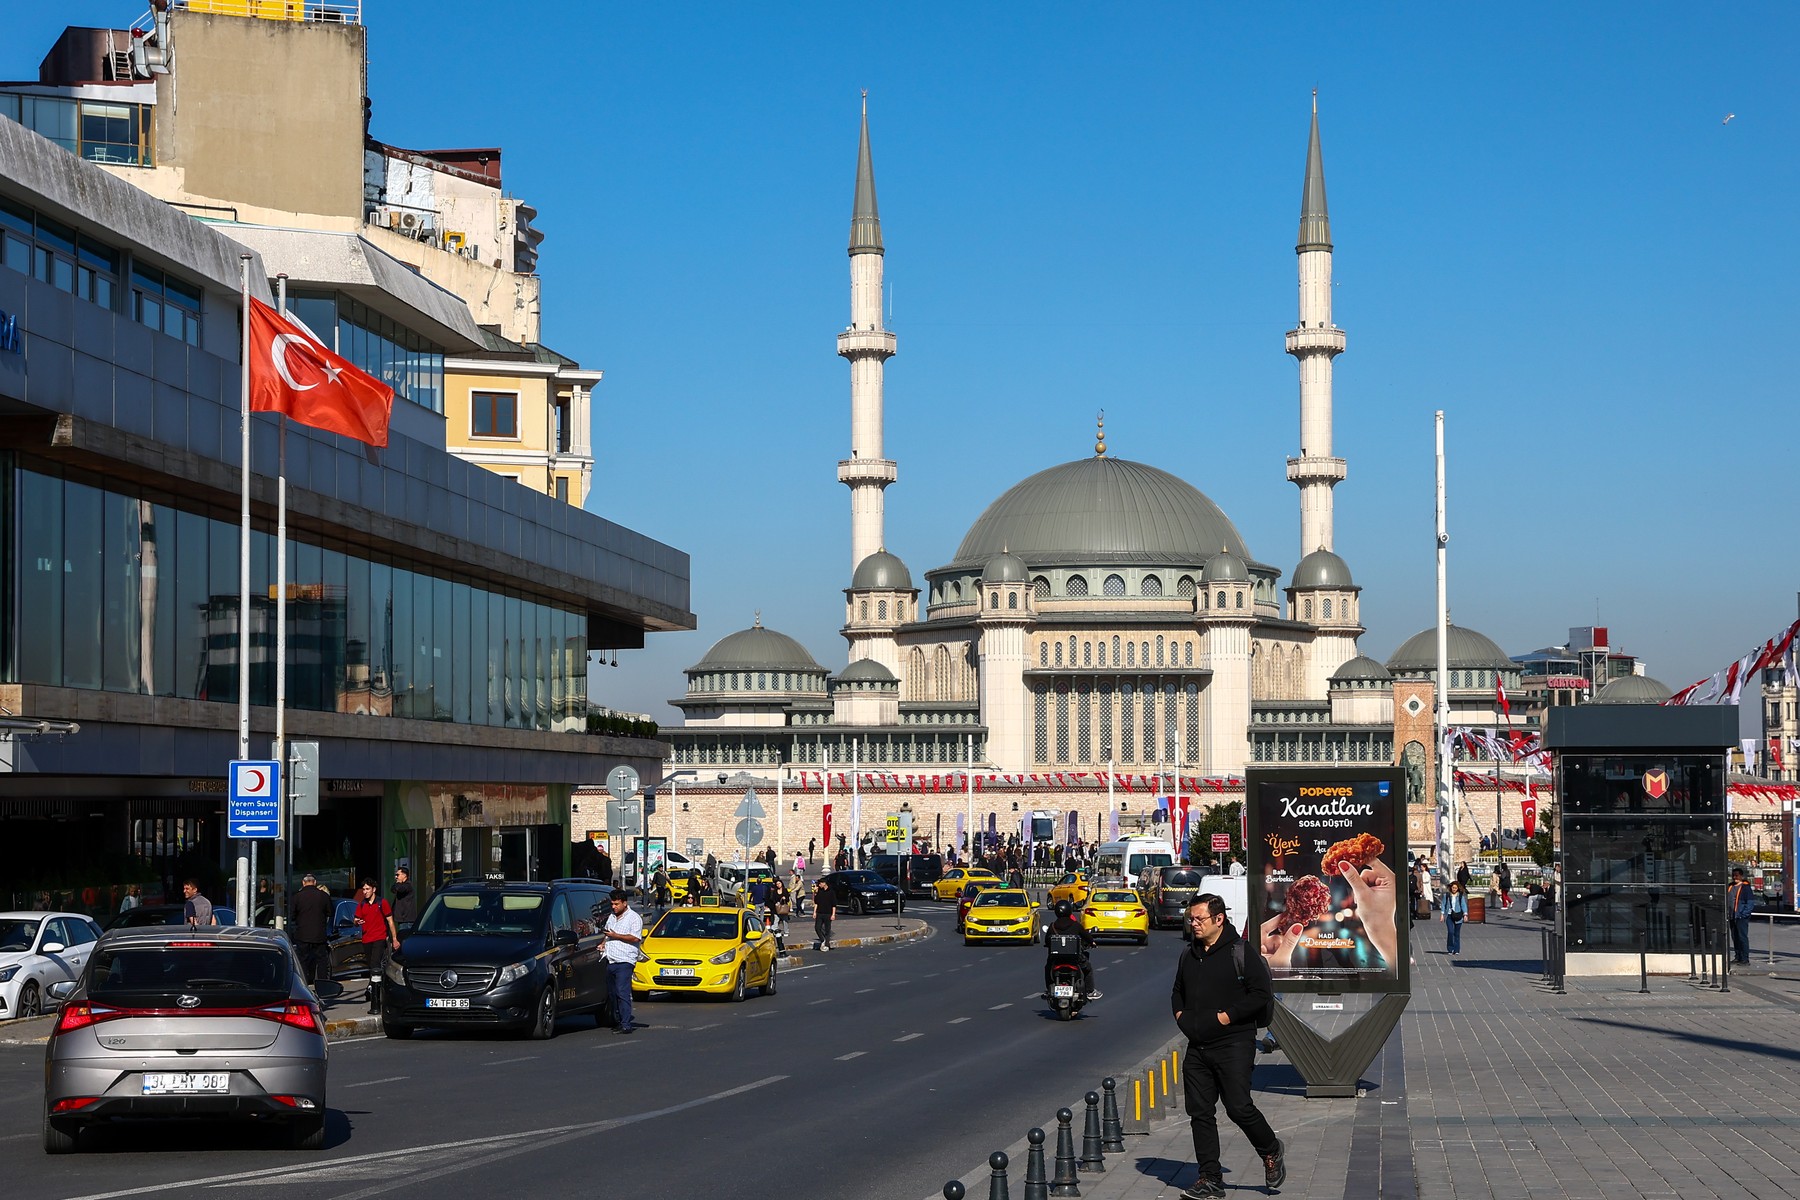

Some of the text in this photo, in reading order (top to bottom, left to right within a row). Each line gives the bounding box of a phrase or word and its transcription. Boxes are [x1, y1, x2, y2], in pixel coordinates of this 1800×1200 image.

[1548, 677, 1590, 689] CARTOON
[256, 800, 278, 808] Savaş
[1280, 797, 1374, 818] Kanatları
[235, 809, 273, 817] Dispanseri
[1298, 818, 1353, 829] SOSA DÜŞTÜ!
[1268, 836, 1301, 857] Yeni
[429, 999, 469, 1007] 34 TFB 85
